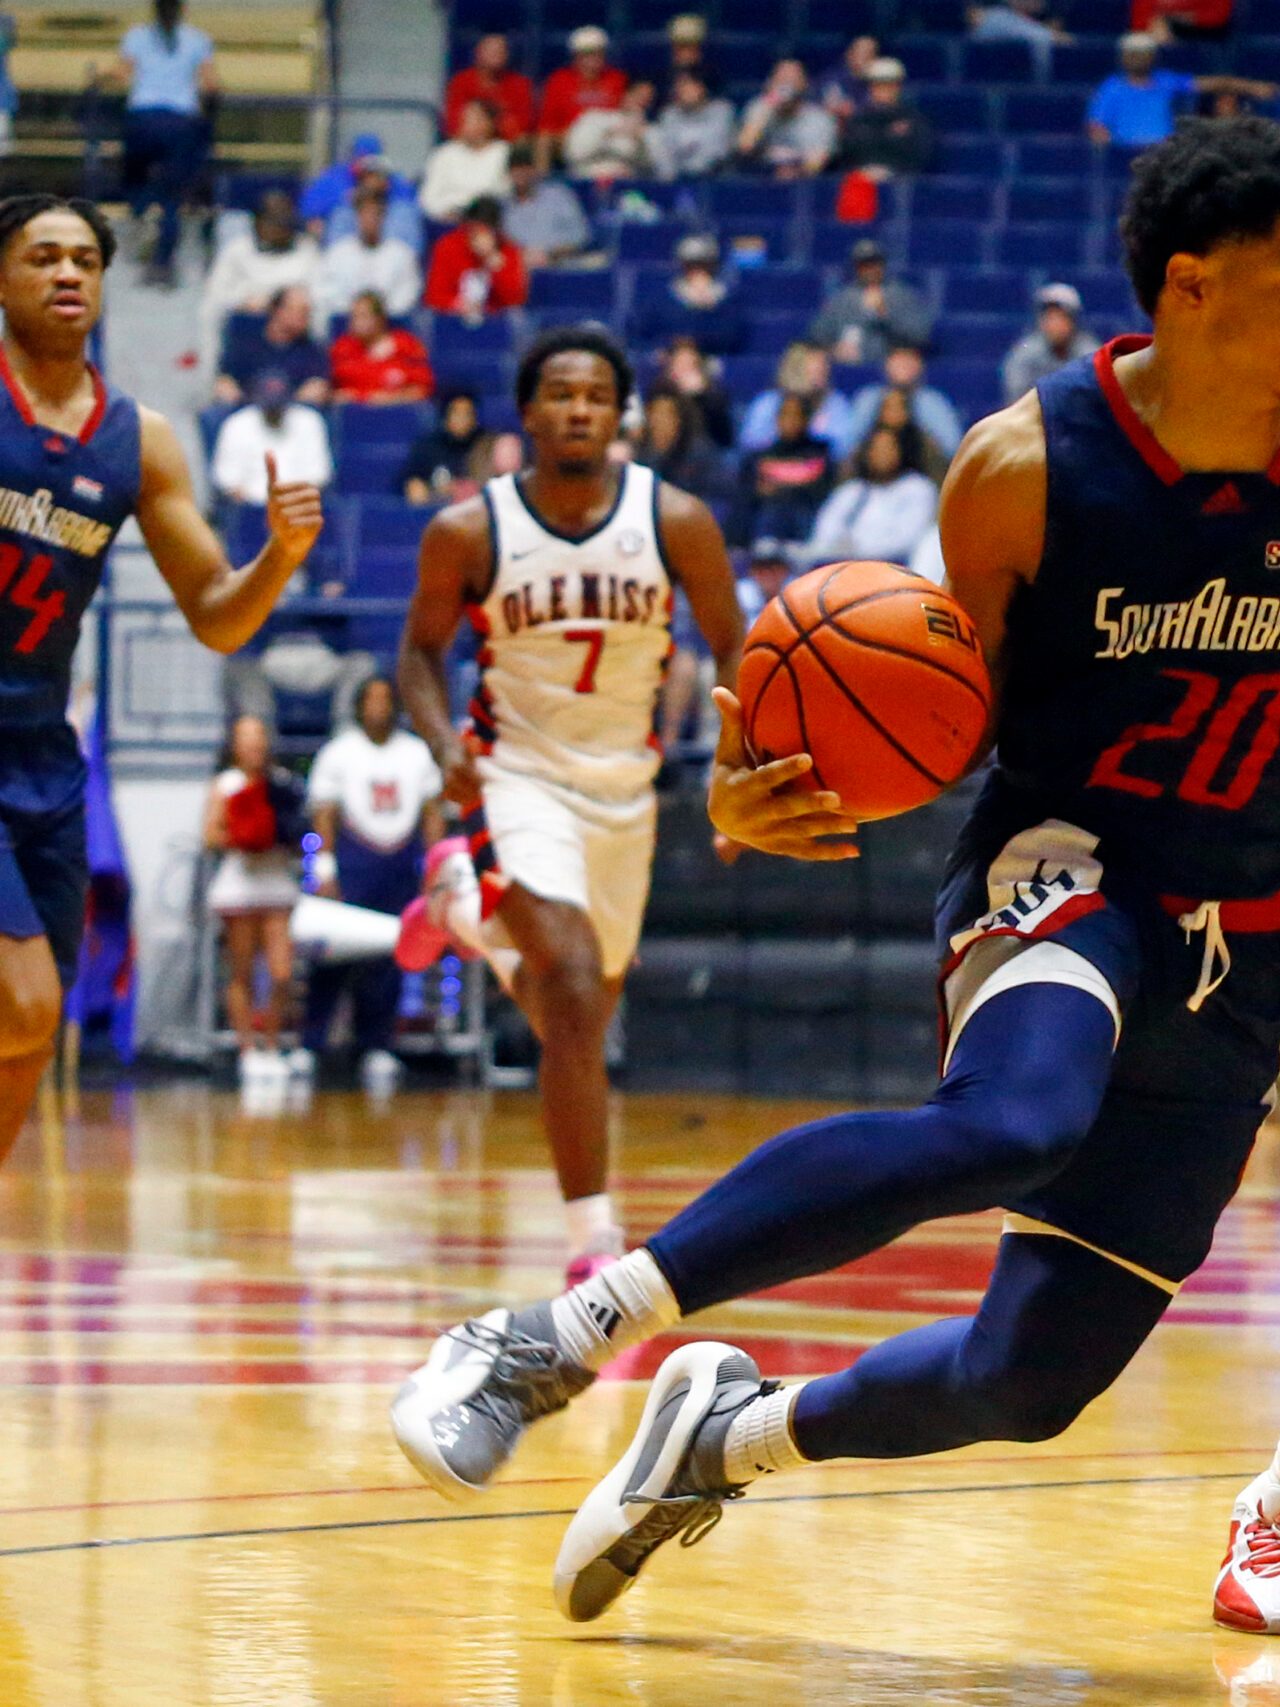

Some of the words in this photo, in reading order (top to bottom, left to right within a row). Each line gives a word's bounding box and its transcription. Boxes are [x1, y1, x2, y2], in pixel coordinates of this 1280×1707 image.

[502, 576, 568, 634] OLE
[580, 573, 657, 625] MISS
[563, 630, 605, 694] 7
